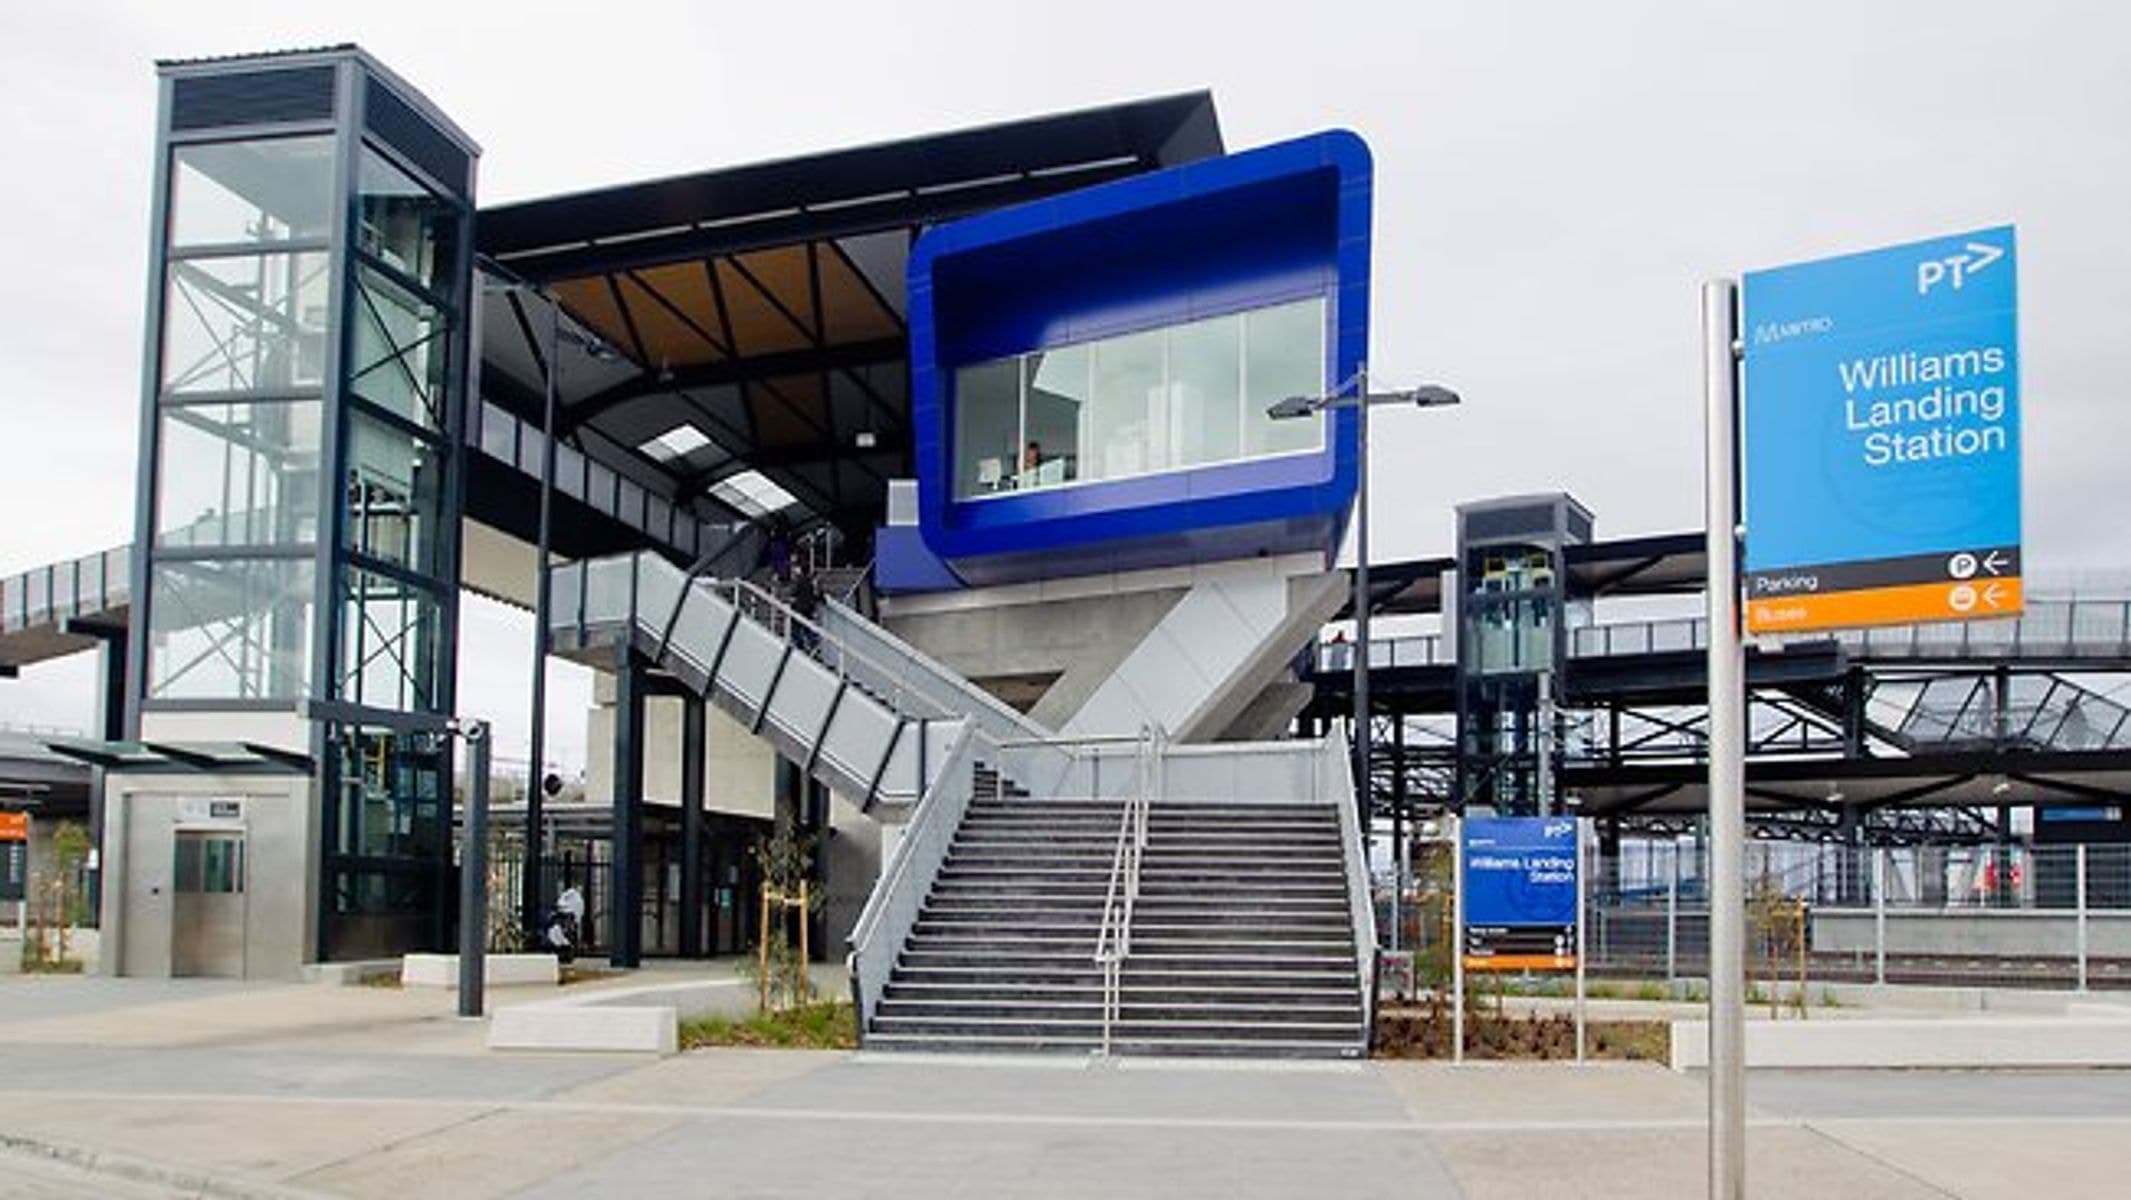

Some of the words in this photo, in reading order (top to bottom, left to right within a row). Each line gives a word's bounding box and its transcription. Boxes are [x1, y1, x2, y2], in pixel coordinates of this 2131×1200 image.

[1838, 346, 2005, 394] Williams
[1845, 385, 2005, 431] Landing
[1864, 424, 2005, 466] Station
[1757, 573, 1818, 593] Parking
[1524, 856, 1575, 871] Landing
[1529, 871, 1575, 883] Station
